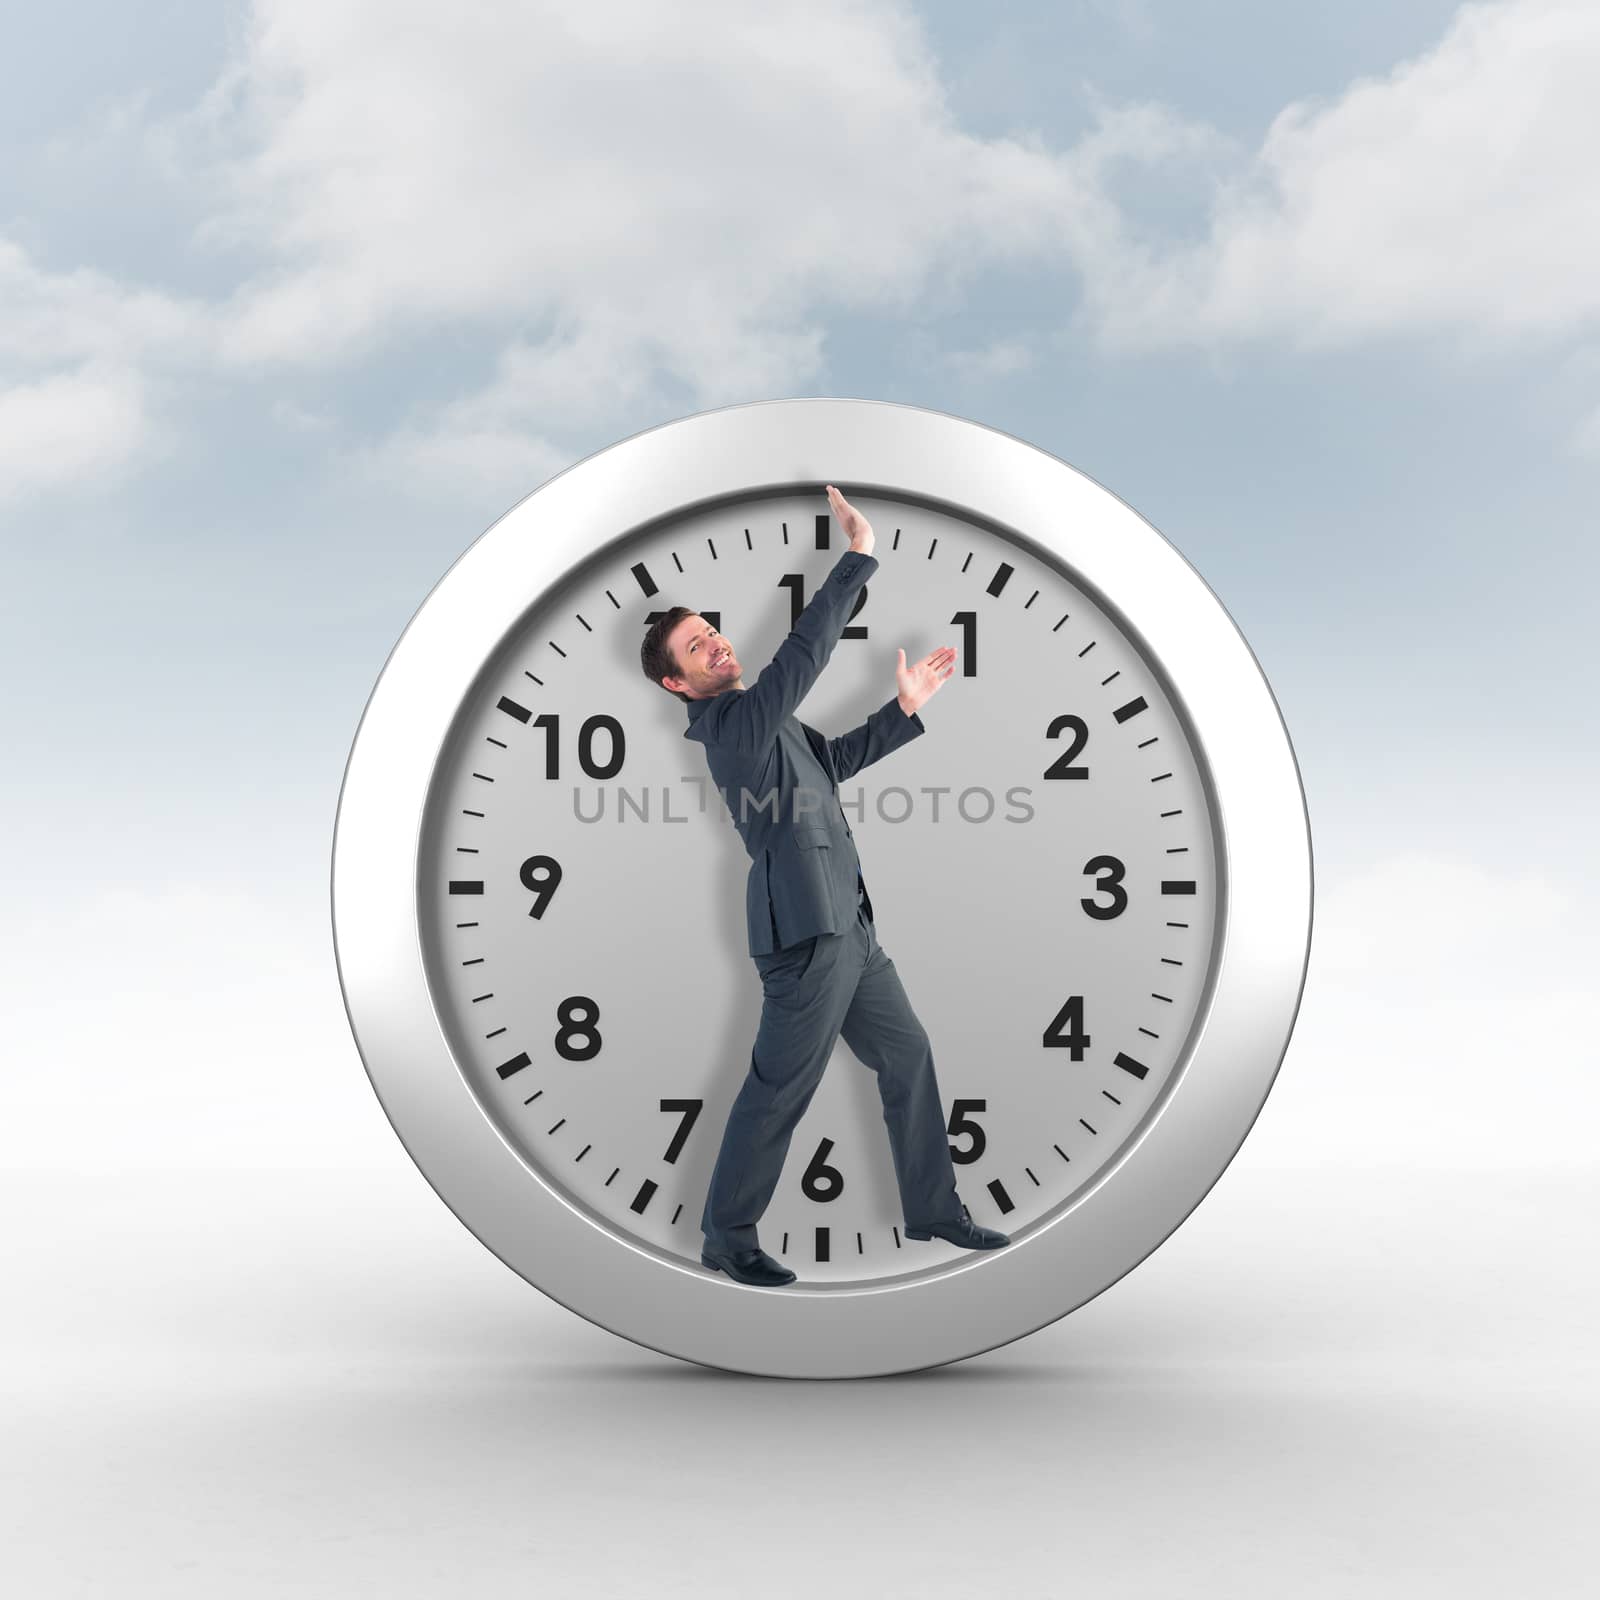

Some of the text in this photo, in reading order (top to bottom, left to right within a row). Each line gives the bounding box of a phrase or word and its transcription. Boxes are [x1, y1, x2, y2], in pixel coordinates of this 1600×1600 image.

[950, 611, 977, 677] 1
[532, 714, 626, 780] 10
[1043, 714, 1089, 780] 2
[519, 855, 563, 921] 9
[1080, 855, 1128, 921] 3
[554, 995, 603, 1062] 8
[1042, 995, 1091, 1062] 4
[659, 1098, 704, 1165] 7
[946, 1099, 986, 1165] 5
[800, 1137, 845, 1203] 6
